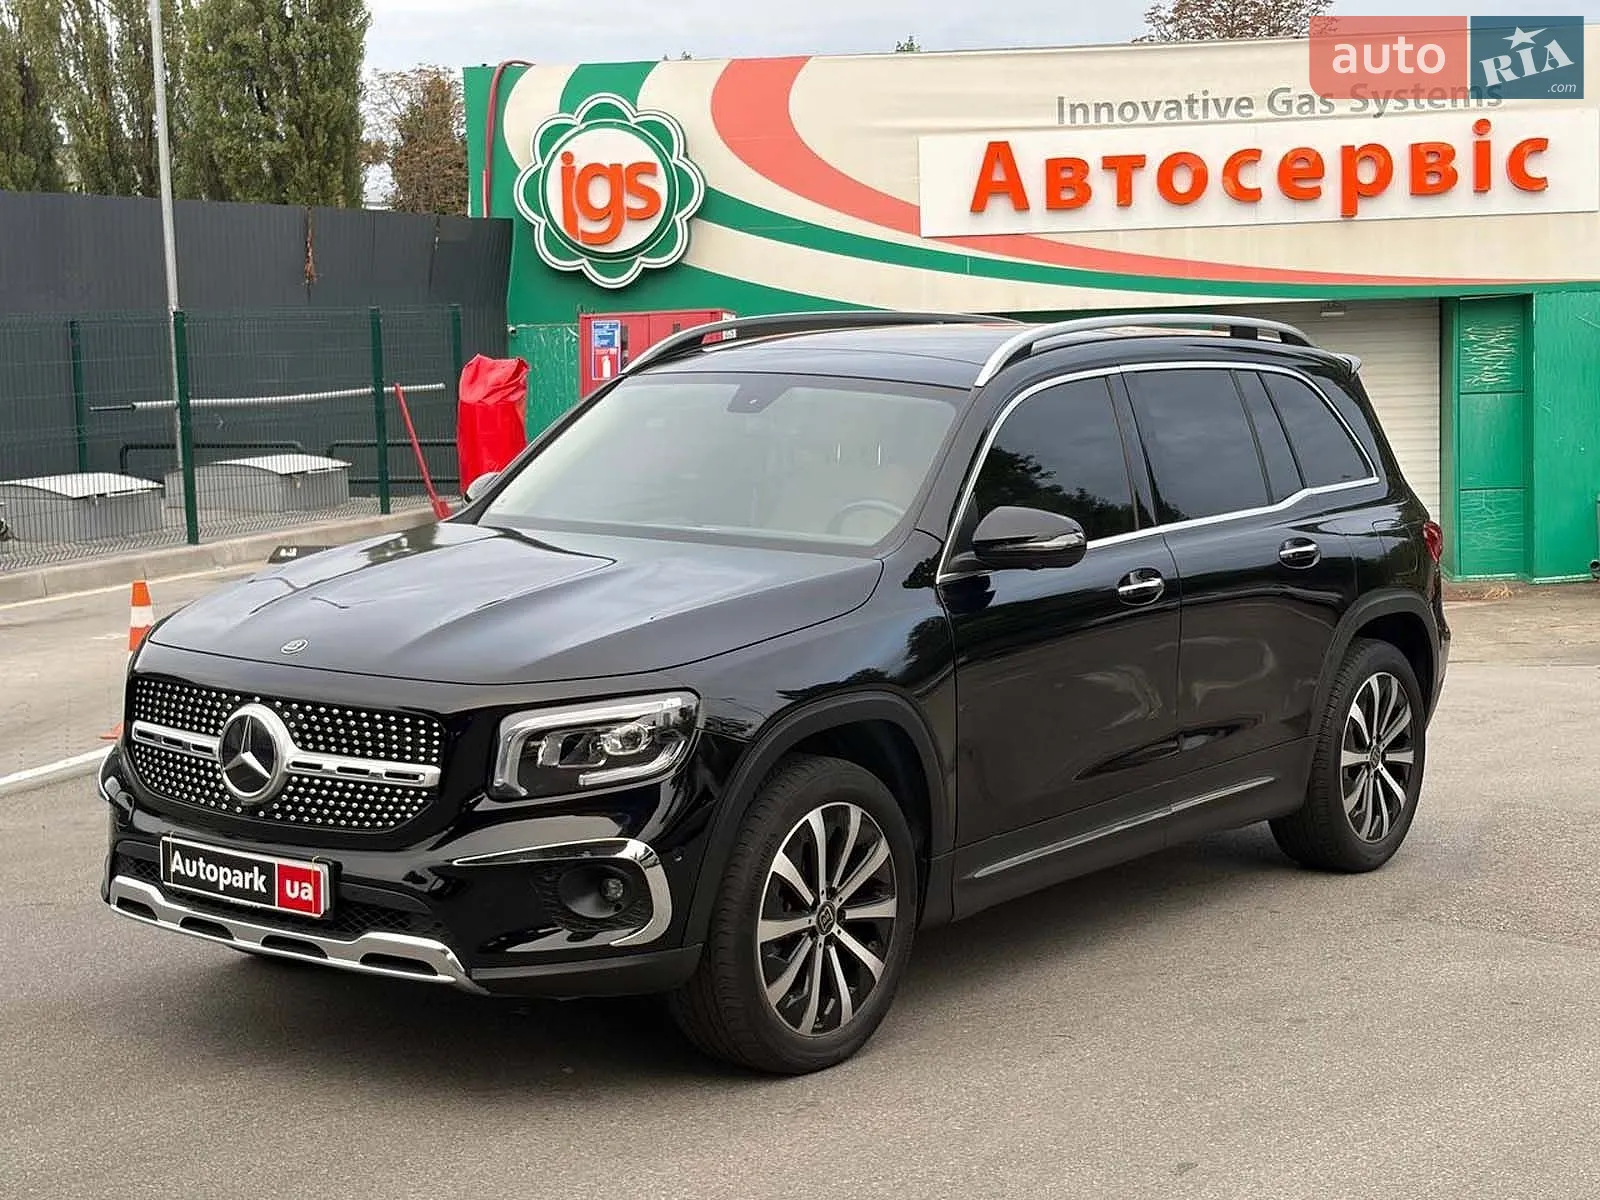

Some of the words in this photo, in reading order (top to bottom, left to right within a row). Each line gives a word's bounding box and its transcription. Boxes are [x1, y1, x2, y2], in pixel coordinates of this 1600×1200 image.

[1057, 89, 1255, 125] Innovative
[1267, 87, 1335, 116] Gas
[1350, 82, 1503, 118] Systems
[560, 151, 661, 245] igs
[970, 118, 1549, 218] Автосервіс
[171, 850, 267, 893] Autopark
[285, 878, 314, 900] ua
